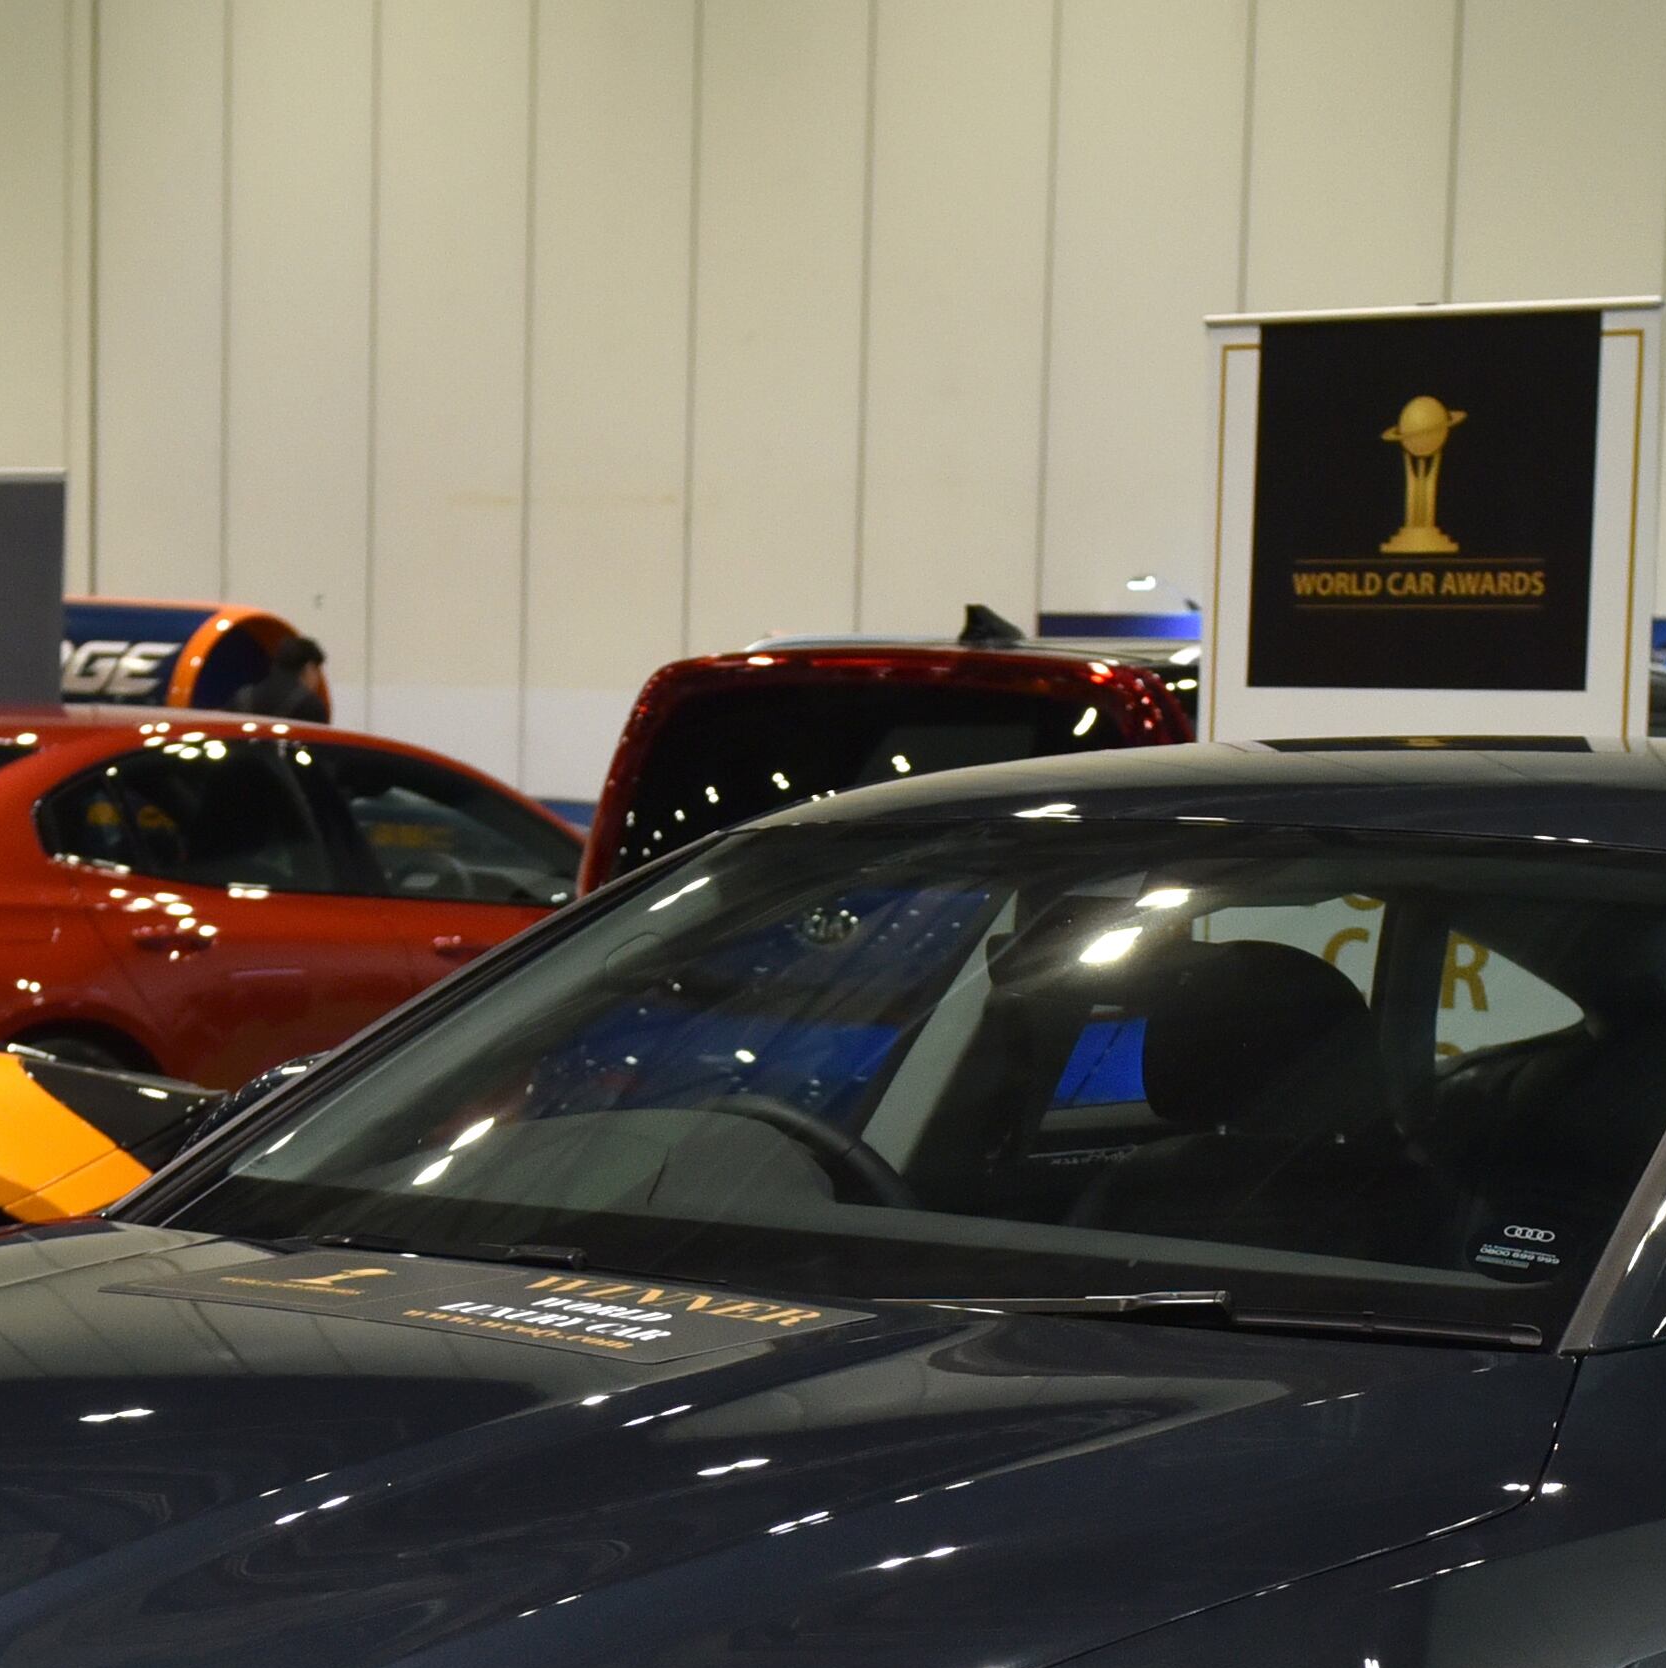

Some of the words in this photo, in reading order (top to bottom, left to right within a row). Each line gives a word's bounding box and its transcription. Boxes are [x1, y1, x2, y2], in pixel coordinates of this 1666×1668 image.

[1293, 571, 1382, 597] WORLD
[1386, 571, 1435, 596] CAR
[1439, 570, 1546, 597] AWARDS
[60, 639, 182, 695] GE
[437, 1301, 584, 1328] LUXURY
[585, 1322, 672, 1341] CAR
[525, 1274, 822, 1328] WINNER
[530, 1296, 673, 1322] WORLD
